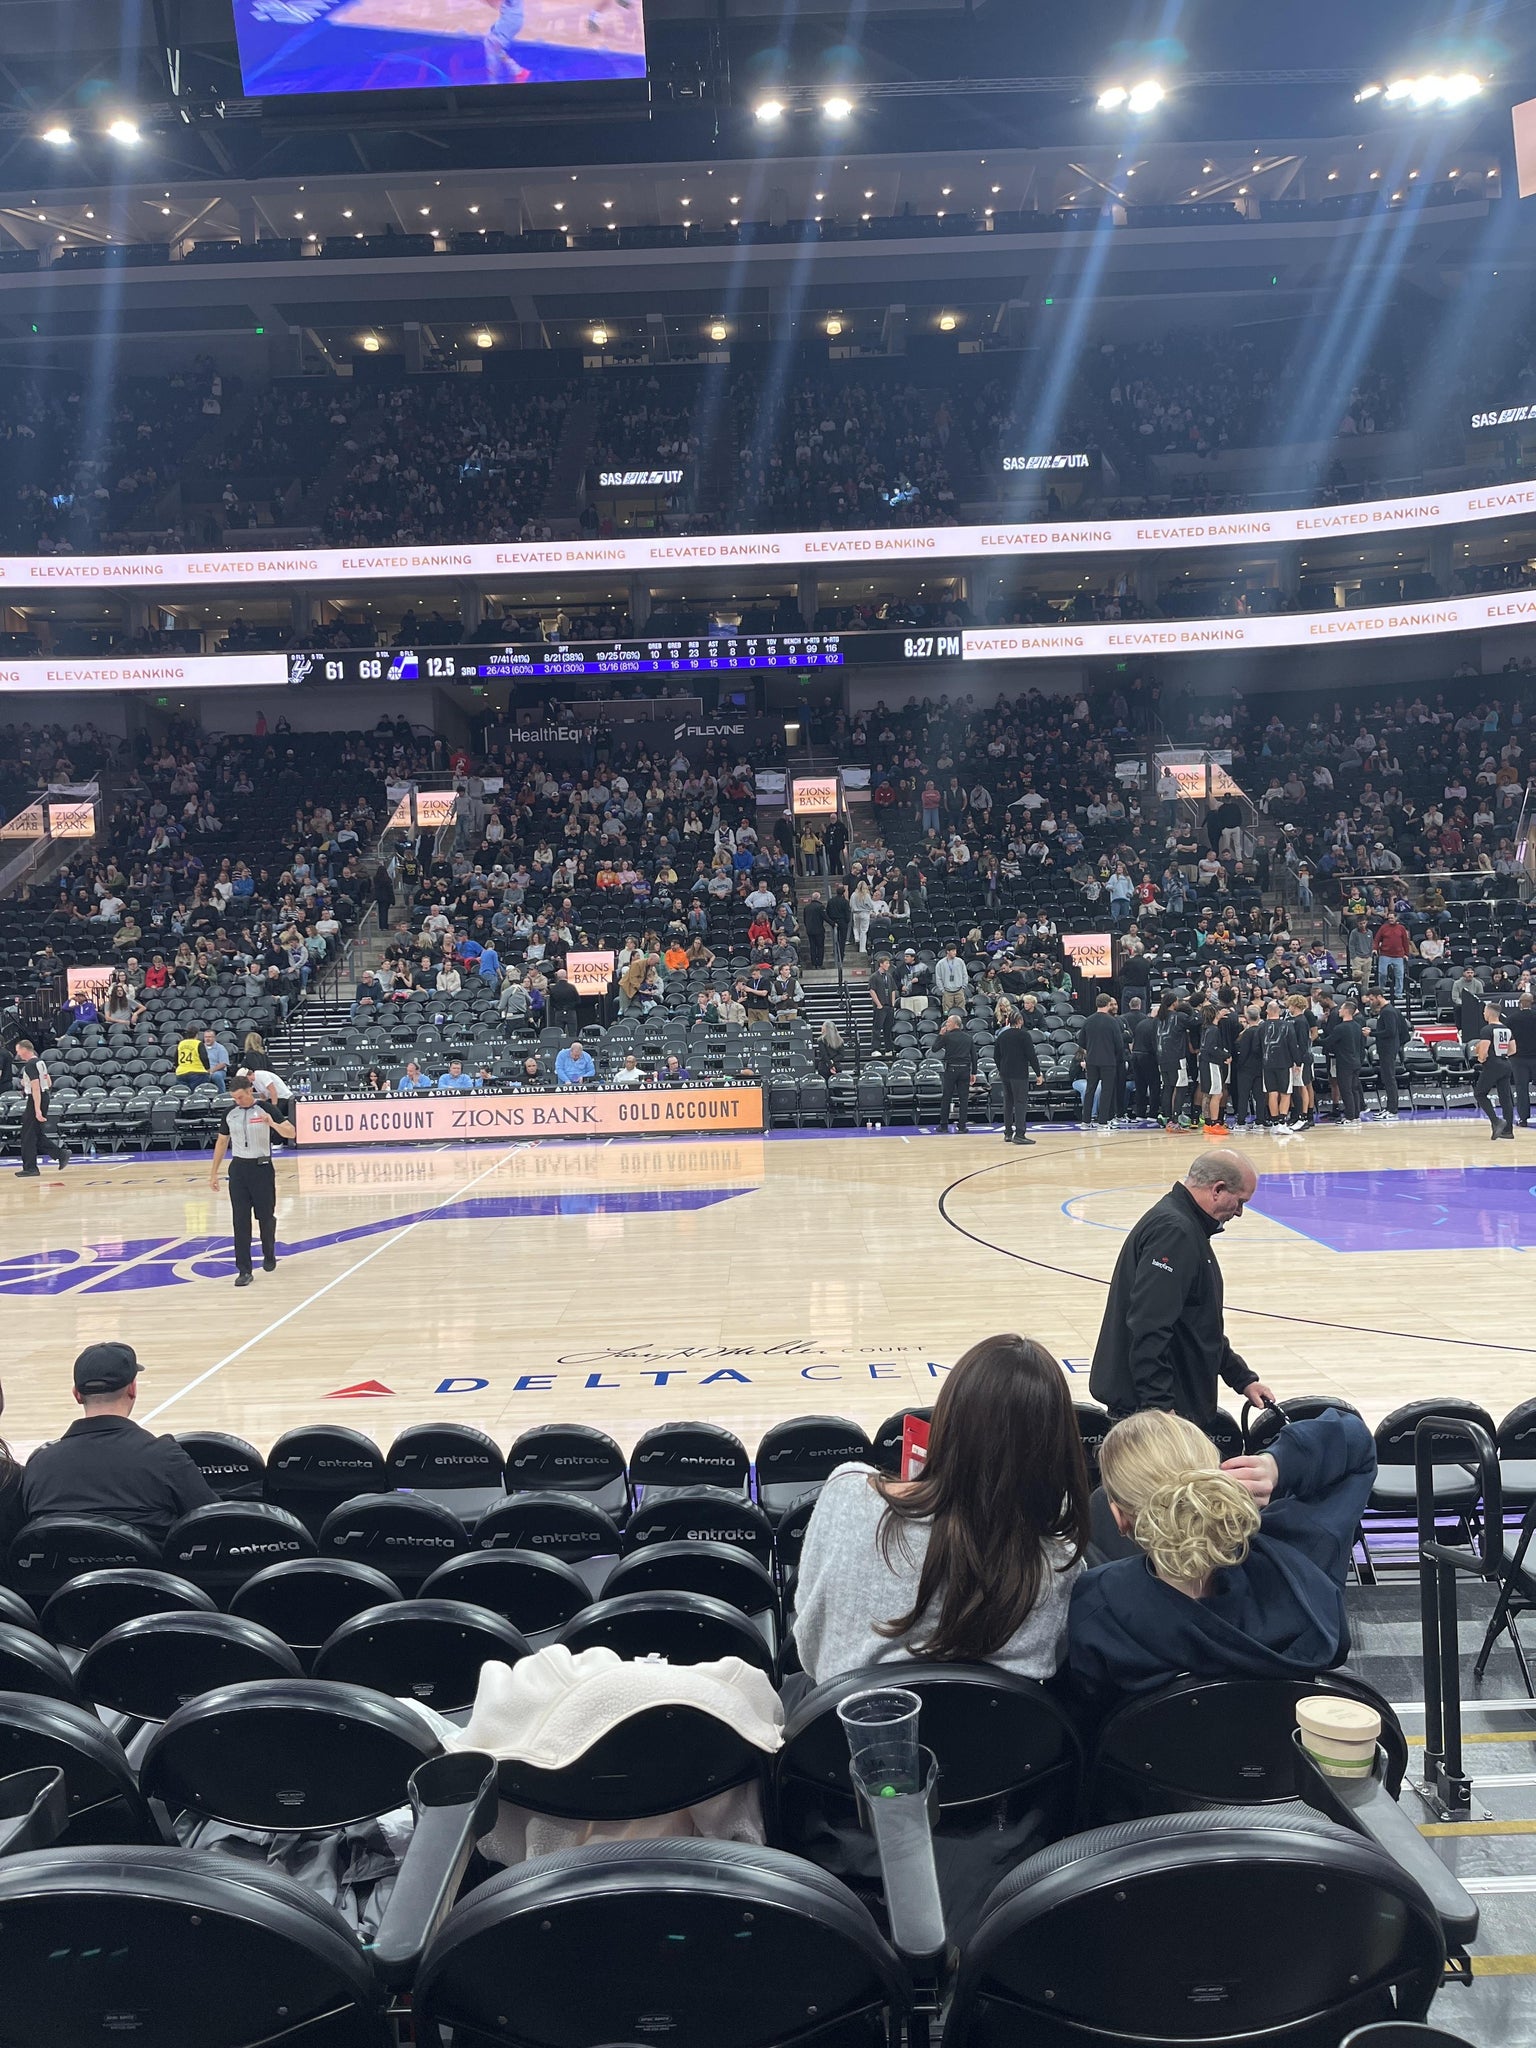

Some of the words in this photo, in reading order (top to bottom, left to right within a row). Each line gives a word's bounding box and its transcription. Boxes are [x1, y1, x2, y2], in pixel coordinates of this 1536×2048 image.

[1471, 412, 1497, 428] SAS
[1003, 457, 1026, 471] SAS
[1067, 454, 1089, 468] UTA
[600, 472, 623, 486] SAS
[1468, 490, 1536, 511] ELEVATE
[1296, 513, 1369, 530] ELEVATED
[1372, 505, 1440, 522] BANKING
[981, 533, 1048, 546] ELEVATED
[1051, 530, 1112, 543] BANKING
[1136, 526, 1205, 540] ELEVATED
[1208, 522, 1271, 536] BANKING
[649, 546, 717, 559] ELEVATED
[719, 543, 781, 556] BANKING
[804, 540, 872, 553] ELEVATED
[874, 537, 936, 550] BANKING
[341, 557, 409, 569] ELEVATED
[411, 554, 472, 567] BANKING
[496, 551, 563, 564] ELEVATED
[565, 549, 626, 561] BANKING
[30, 566, 100, 577] ELEVATED
[102, 564, 164, 576] BANKING
[187, 561, 255, 574] ELEVATED
[257, 560, 318, 572] BANKING
[1487, 603, 1536, 617] ELEVA
[1310, 620, 1383, 635] ELEVATED
[1388, 611, 1458, 628] BANKING
[1022, 637, 1084, 649] BANKING
[1108, 633, 1177, 645] ELEVATED
[1180, 629, 1244, 642] BANKING
[489, 655, 510, 664] 17/41
[510, 654, 530, 664] (41%)
[544, 654, 561, 662] 8/21
[562, 653, 584, 662] (38%)
[596, 652, 619, 661] 19/25
[619, 651, 640, 661] (76%)
[650, 651, 659, 659] 10
[670, 650, 679, 658] 13
[689, 650, 699, 658] 23
[730, 648, 735, 656] 8
[749, 647, 755, 655] 0
[767, 647, 776, 655] 15
[790, 646, 795, 654] 9
[806, 645, 817, 653] 99
[825, 644, 837, 652] 116
[904, 637, 934, 657] 8:27
[938, 637, 959, 655] PM
[326, 661, 344, 680] 61
[359, 660, 381, 679] 68
[426, 658, 455, 677] 12.5
[461, 667, 476, 676] 3RD
[486, 666, 510, 675] 26/43
[512, 666, 533, 675] (60%)
[544, 665, 561, 673] 3/10
[563, 664, 584, 673] (30%)
[599, 663, 618, 671] 13/16
[620, 663, 639, 671] (81%)
[671, 661, 679, 669] 16
[691, 660, 699, 668] 19
[710, 660, 718, 668] 15
[730, 659, 737, 667] 13
[750, 658, 755, 666] 0
[807, 656, 817, 664] 117
[825, 655, 838, 663] 102
[47, 670, 118, 681] ELEVATED
[123, 667, 184, 679] BANKING
[509, 726, 598, 744] HealthEqit
[687, 724, 744, 737] FILEVINE
[799, 787, 831, 796] ZIONS
[422, 800, 454, 809] ZIONS
[55, 812, 87, 820] ZIONS
[1069, 946, 1105, 955] ZIONS
[573, 963, 609, 973] ZIONS
[74, 979, 110, 989] ZIONS
[180, 1052, 193, 1064] 24
[619, 1103, 660, 1120] GOLD
[665, 1100, 739, 1119] ACCOUNT
[312, 1115, 353, 1132] GOLD
[360, 1111, 434, 1130] ACCOUNT
[452, 1109, 524, 1127] ZIONS
[434, 1369, 753, 1394] DELTA
[801, 1357, 1090, 1381] CENE
[808, 1445, 864, 1457] entrata
[318, 1459, 373, 1469] entrata
[434, 1454, 489, 1465] entrata
[554, 1456, 609, 1465] entrata
[680, 1456, 735, 1467] entrata
[531, 1530, 601, 1544] entrata
[687, 1528, 756, 1541] entrata
[229, 1540, 300, 1556] entrata
[385, 1536, 455, 1548] entrata
[68, 1554, 138, 1564] entrata
